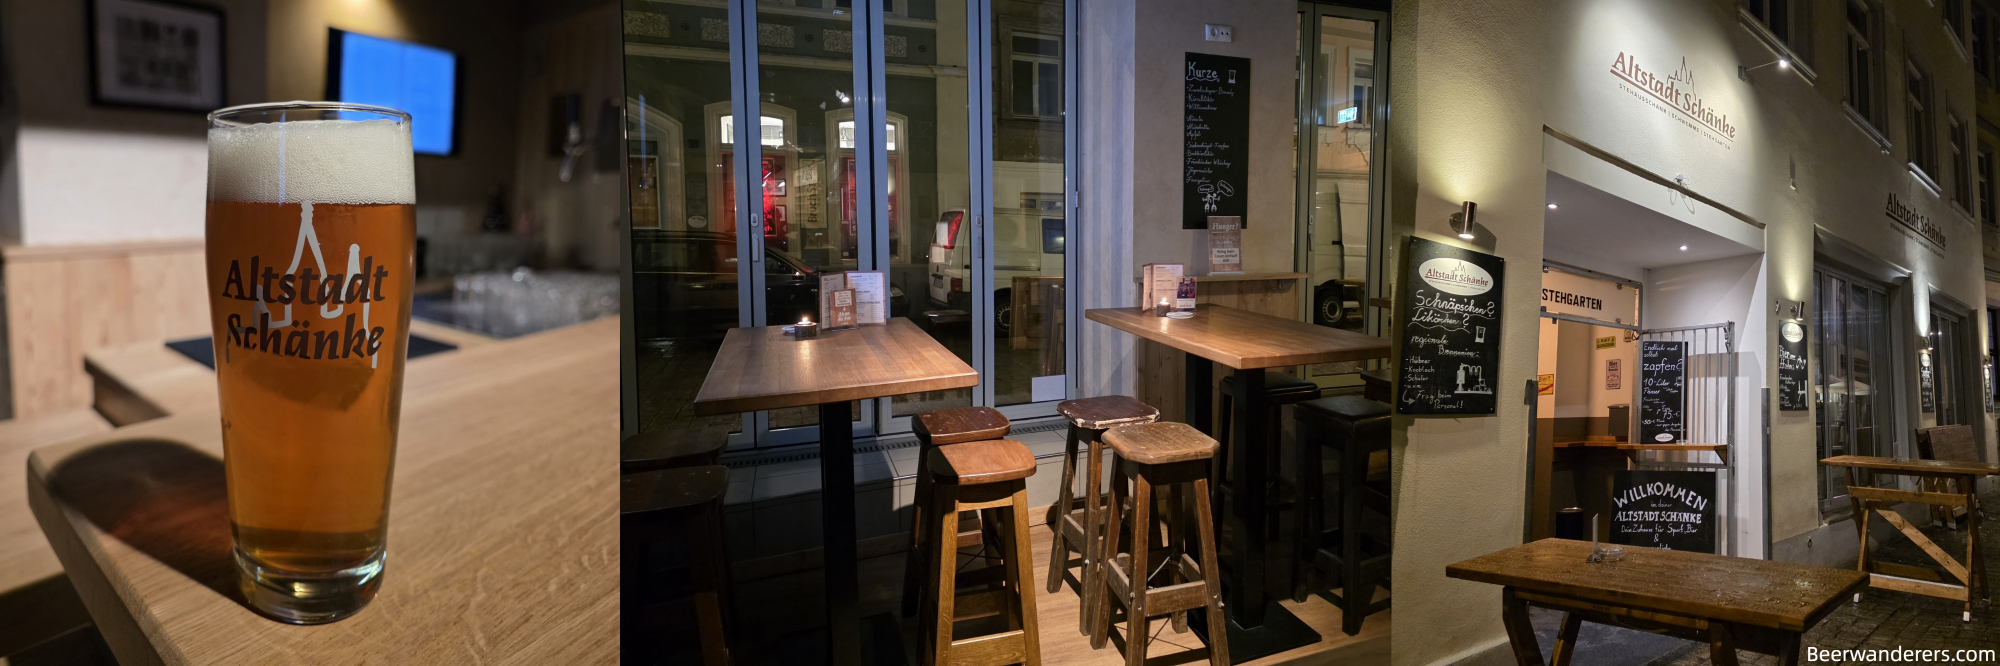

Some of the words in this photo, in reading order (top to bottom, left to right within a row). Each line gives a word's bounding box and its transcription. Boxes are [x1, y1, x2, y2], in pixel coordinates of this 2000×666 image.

[1187, 61, 1218, 78] Kurze
[1611, 51, 1681, 106] Altstadt
[1682, 92, 1736, 139] Schänke
[1886, 192, 1919, 230] Altstadt
[1212, 222, 1239, 232] Hunger?
[222, 255, 389, 305] Altstadt
[1425, 268, 1458, 281] Altstadt
[1459, 275, 1489, 286] Schänke
[1542, 288, 1602, 311] STEHGARTEN
[227, 313, 385, 360] Schänke
[1437, 389, 1452, 399] beim
[1613, 481, 1708, 511] WILLKOMMEN
[1614, 510, 1660, 522] ALTSTADT
[1655, 523, 1664, 533] für
[1653, 533, 1660, 543] &
